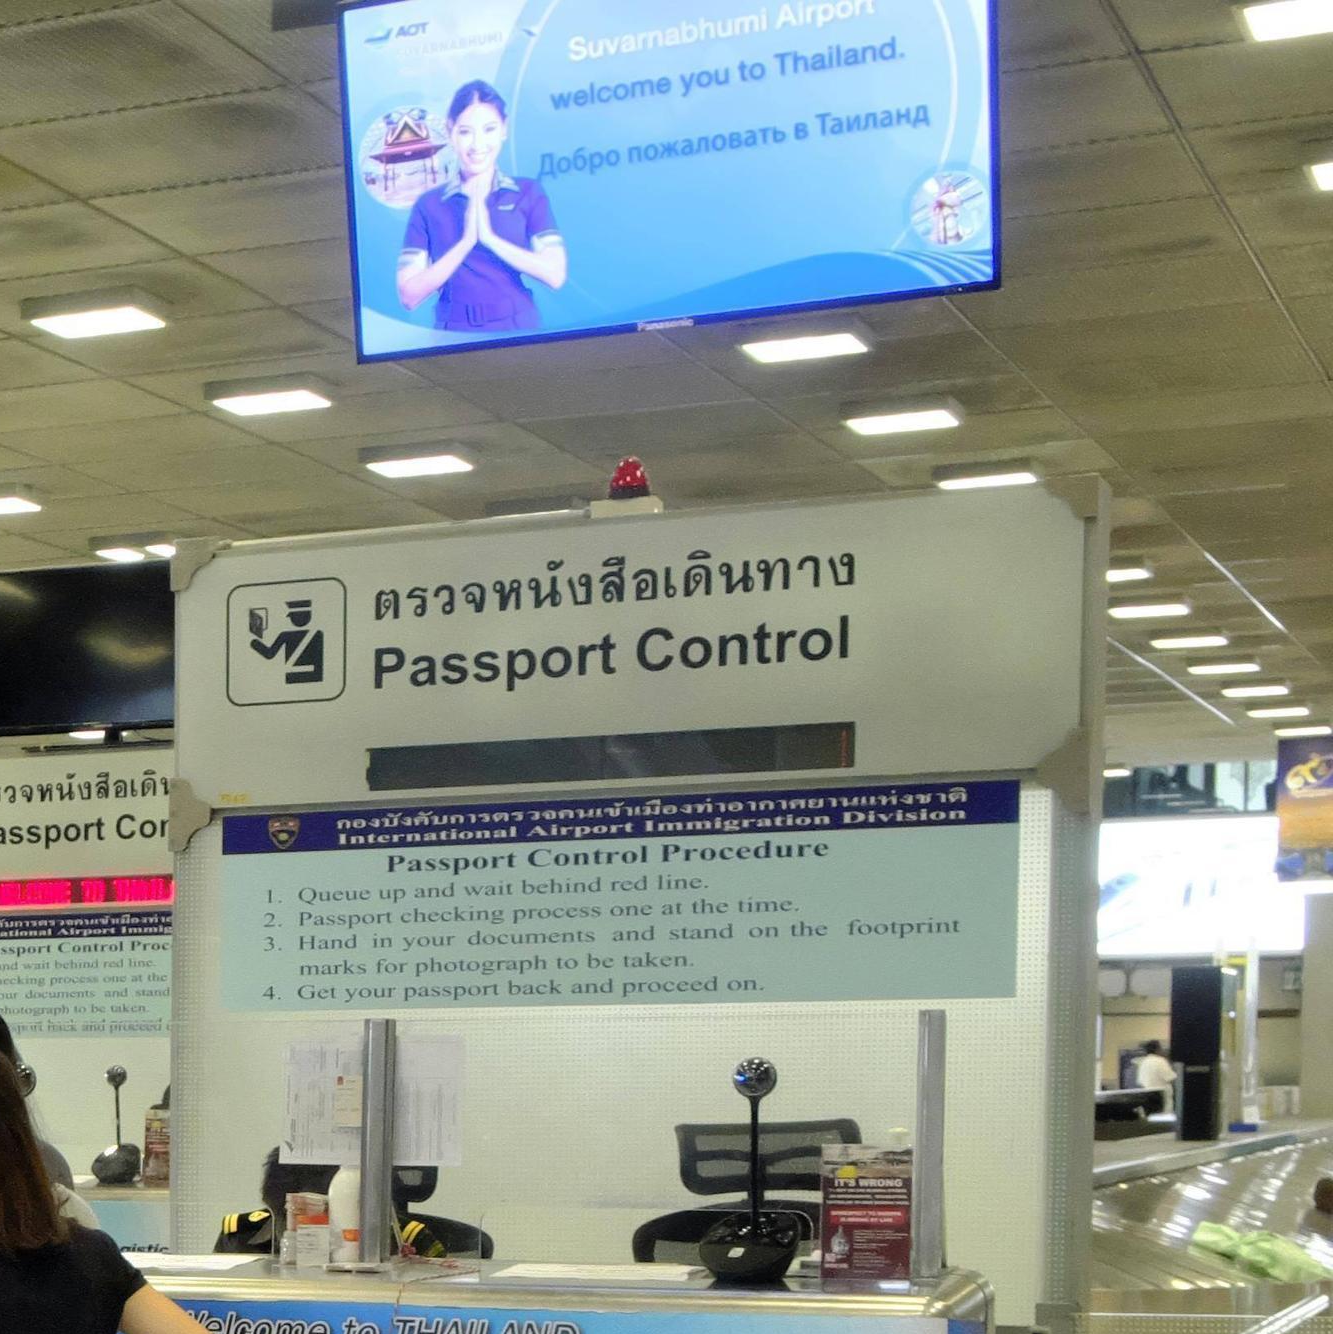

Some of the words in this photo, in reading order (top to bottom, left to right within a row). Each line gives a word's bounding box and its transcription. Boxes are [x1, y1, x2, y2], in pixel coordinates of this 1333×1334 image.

[395, 22, 430, 38] AOT
[568, 8, 768, 62] Suvarnabhumi
[775, 0, 876, 29] Airport
[549, 76, 672, 110] welcome
[679, 65, 731, 98] you
[737, 60, 766, 83] to
[773, 36, 905, 76] Thailand.
[537, 146, 621, 180] Добро
[627, 125, 786, 164] пожаловать
[793, 121, 810, 140] в
[815, 104, 931, 137] Таиланд
[373, 547, 857, 622] ตรวจหนังสือเดินทาง
[373, 632, 616, 695] Passport
[635, 615, 851, 673] Control
[337, 826, 518, 846] International
[527, 820, 634, 840] Airport
[645, 814, 830, 834] Immigration
[842, 807, 967, 825] Division
[386, 852, 516, 874] Passport
[527, 845, 647, 867] Control
[662, 840, 829, 863] Procedure
[267, 889, 283, 904] 1.
[298, 886, 371, 905] Queue
[379, 887, 406, 903] up
[414, 883, 455, 899] and
[463, 881, 513, 897] wait
[521, 877, 602, 895] behind
[610, 876, 648, 892] red
[657, 874, 710, 891] line.
[263, 912, 283, 928] 2.
[298, 910, 391, 930] Passport
[400, 906, 504, 925] checking
[512, 905, 602, 924] process
[609, 903, 653, 917] one
[661, 901, 683, 916] at
[692, 899, 729, 915] the
[737, 897, 800, 914] time.
[57, 926, 116, 937] Airport
[57, 941, 124, 953] Control
[263, 936, 283, 952] 3.
[298, 934, 358, 951] Hand
[372, 933, 393, 949] in
[402, 934, 456, 952] your
[467, 929, 596, 947] documents
[612, 925, 655, 942] and
[669, 924, 734, 941] stand
[748, 924, 779, 938] on
[790, 920, 829, 937] the
[848, 917, 960, 939] footprint
[23, 960, 50, 970] wait
[54, 959, 99, 970] behind
[103, 958, 124, 968] red
[300, 958, 367, 976] marks
[376, 957, 407, 974] for
[415, 955, 547, 977] photograph
[556, 956, 578, 970] to
[587, 953, 615, 969] be
[623, 952, 695, 969] taken.
[25, 989, 96, 999] documents
[49, 974, 99, 987] process
[262, 985, 282, 1001] 4.
[297, 984, 337, 1000] Get
[344, 986, 397, 1003] your
[404, 982, 500, 1000] passport
[508, 979, 562, 996] back
[571, 979, 614, 995] and
[622, 976, 718, 997] proceed
[727, 976, 765, 992] on.
[859, 1178, 903, 1187] WRONG
